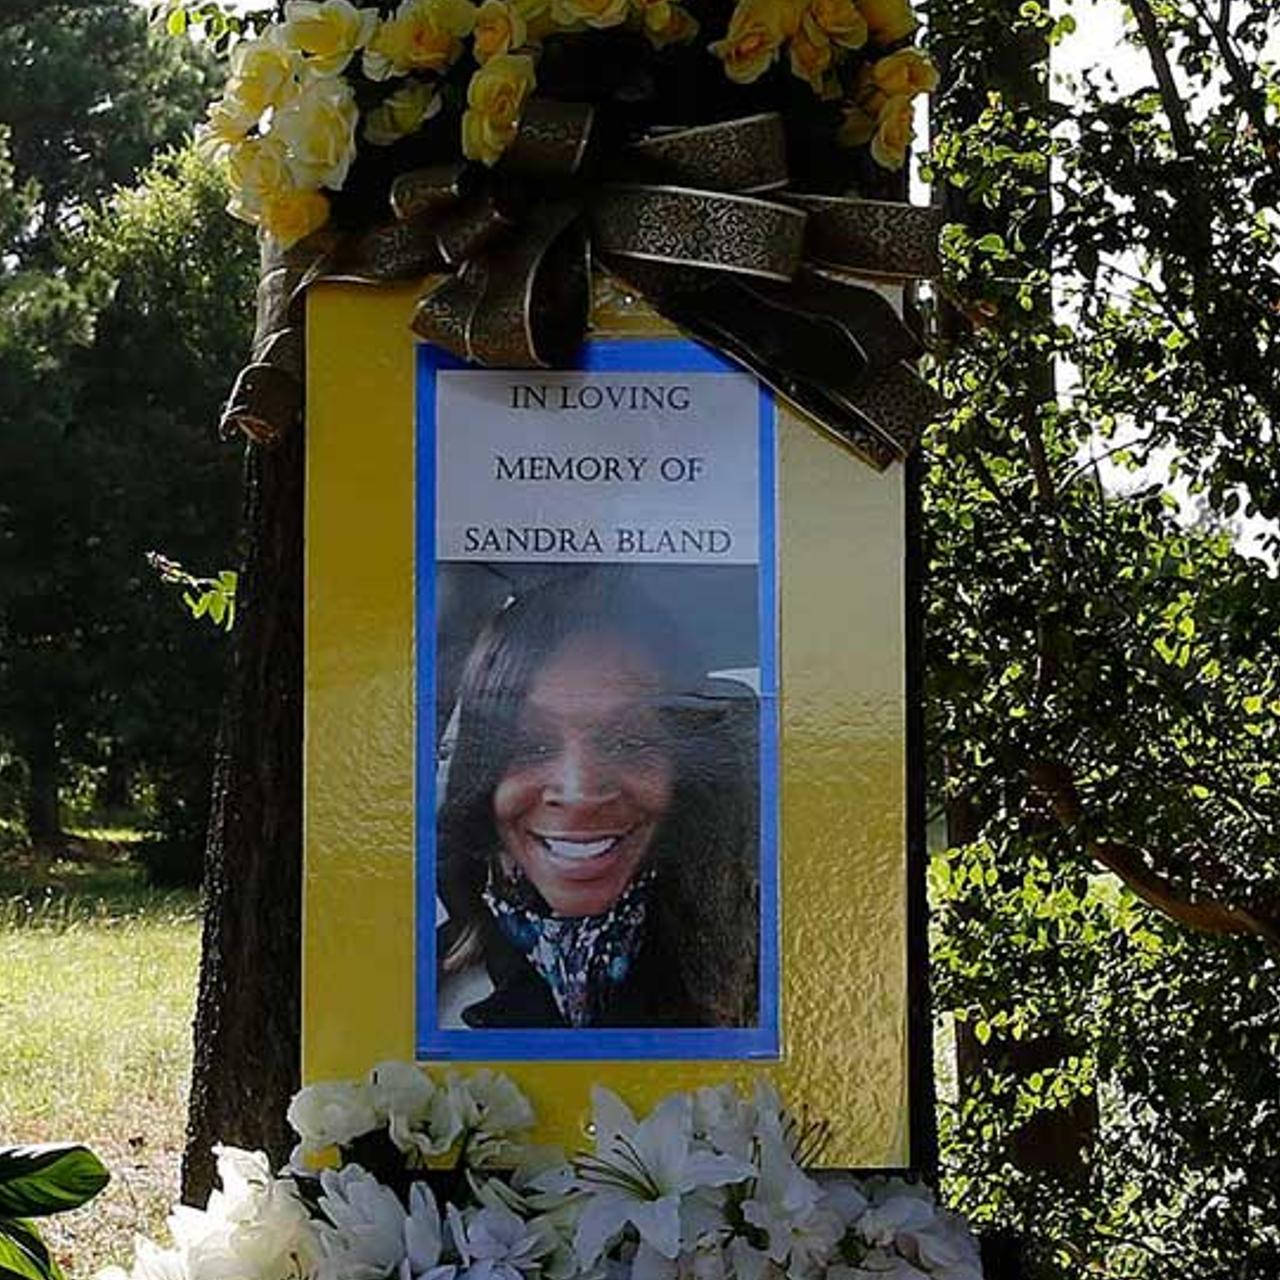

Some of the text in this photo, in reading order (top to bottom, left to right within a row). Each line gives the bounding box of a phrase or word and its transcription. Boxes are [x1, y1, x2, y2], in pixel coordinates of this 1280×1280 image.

[511, 386, 691, 410] IN LOVING
[495, 457, 704, 482] MEMORY OF
[464, 528, 732, 553] SANDRA BLAND
